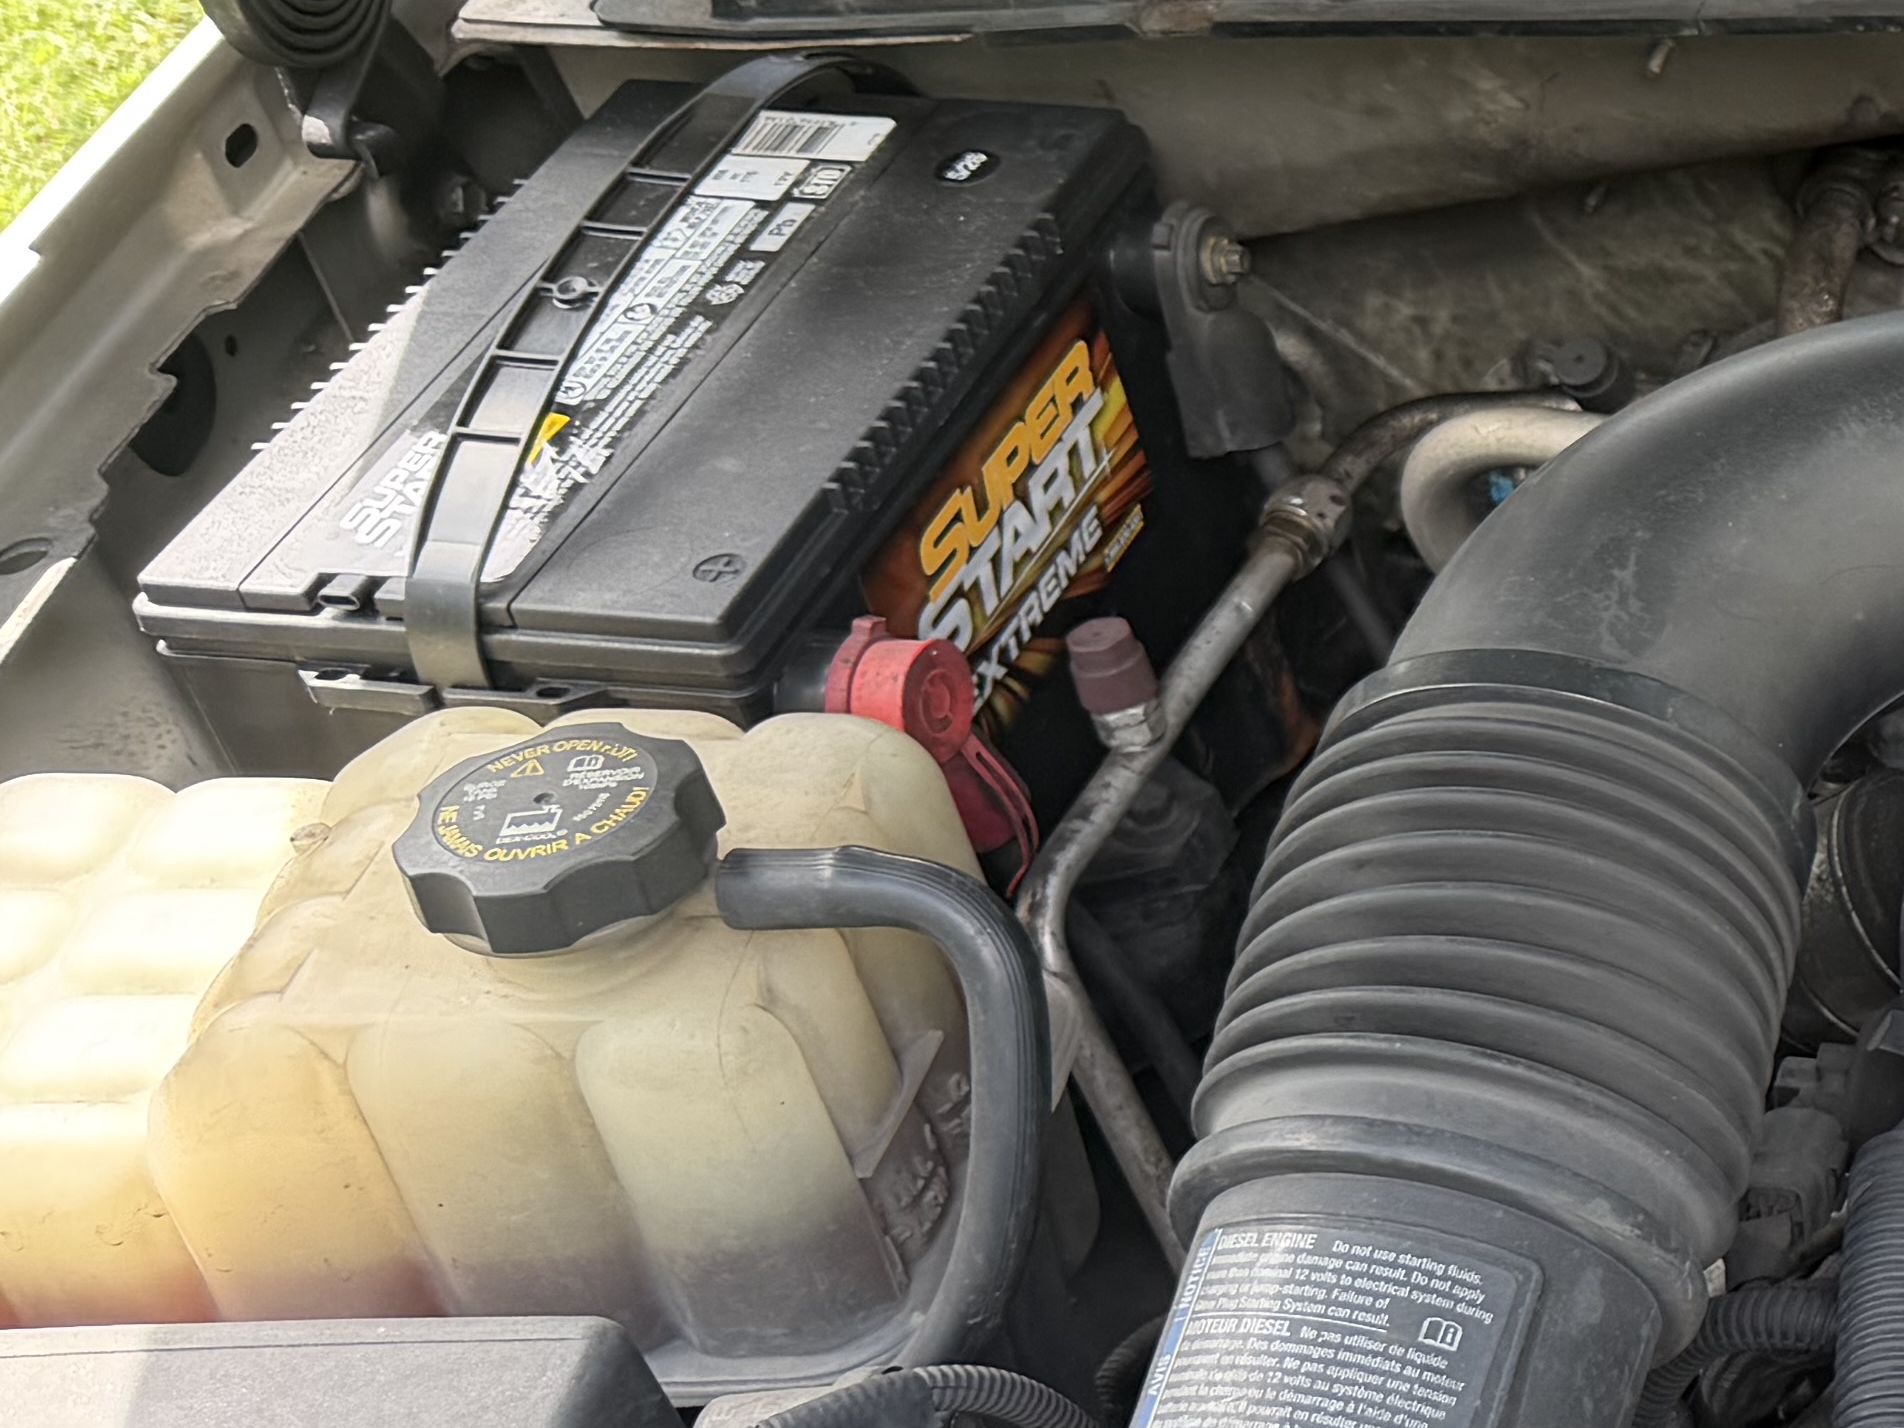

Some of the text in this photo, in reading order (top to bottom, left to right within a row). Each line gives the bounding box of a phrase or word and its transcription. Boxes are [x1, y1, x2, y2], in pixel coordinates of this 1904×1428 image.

[339, 430, 448, 531] SUPER
[920, 340, 1096, 602] SUPER
[918, 387, 1106, 653] START
[487, 744, 551, 773] NEVER
[553, 740, 603, 754] OPEN
[437, 805, 460, 823] NE
[590, 786, 651, 834] CHAUD!
[437, 824, 483, 858] JAMAIS
[484, 839, 571, 862] OUVRIR
[1178, 1245, 1212, 1309] NOTICE
[1217, 1232, 1483, 1285] DIESEL ENGINE Do not use starting fluids.
[1296, 1253, 1343, 1270] damage
[1345, 1260, 1368, 1273] can
[1369, 1264, 1407, 1281] result.
[1411, 1271, 1428, 1286] Do
[1430, 1277, 1452, 1292] not
[1453, 1283, 1485, 1304] apply
[1282, 1298, 1326, 1314] System
[1327, 1307, 1350, 1318] can
[1352, 1310, 1390, 1327] result.
[1295, 1269, 1309, 1280] 12
[1311, 1271, 1338, 1284] volts
[1340, 1273, 1353, 1286] to
[1354, 1276, 1410, 1298] electrical
[1410, 1289, 1454, 1309] system
[1456, 1302, 1494, 1324] during
[1332, 1288, 1373, 1305] Failure
[1375, 1297, 1390, 1309] of
[1185, 1318, 1449, 1369] MOTEUR DIESEL Ne pas utiliser de liquide
[1246, 1337, 1269, 1351] Des
[1270, 1340, 1335, 1360] dommages
[1336, 1349, 1402, 1374] immédiats
[1402, 1365, 1420, 1378] au
[1421, 1371, 1466, 1392] moteur
[1148, 1354, 1172, 1396] AVIS
[1235, 1352, 1280, 1368] résulter.
[1282, 1356, 1301, 1369] Ne
[1301, 1360, 1325, 1374] pas
[1326, 1363, 1385, 1386] appliquer
[1387, 1378, 1411, 1393] une
[1412, 1383, 1457, 1407] tension
[1283, 1374, 1311, 1388] volts
[1313, 1379, 1330, 1391] au
[1332, 1382, 1384, 1403] système
[1386, 1394, 1446, 1420] électrique
[1246, 1404, 1292, 1419] pourrait
[1293, 1409, 1309, 1421] en
[1265, 1387, 1276, 1400] le
[1279, 1389, 1344, 1412] démarrage
[1345, 1400, 1354, 1413] à
[1357, 1404, 1392, 1422] l'aide
